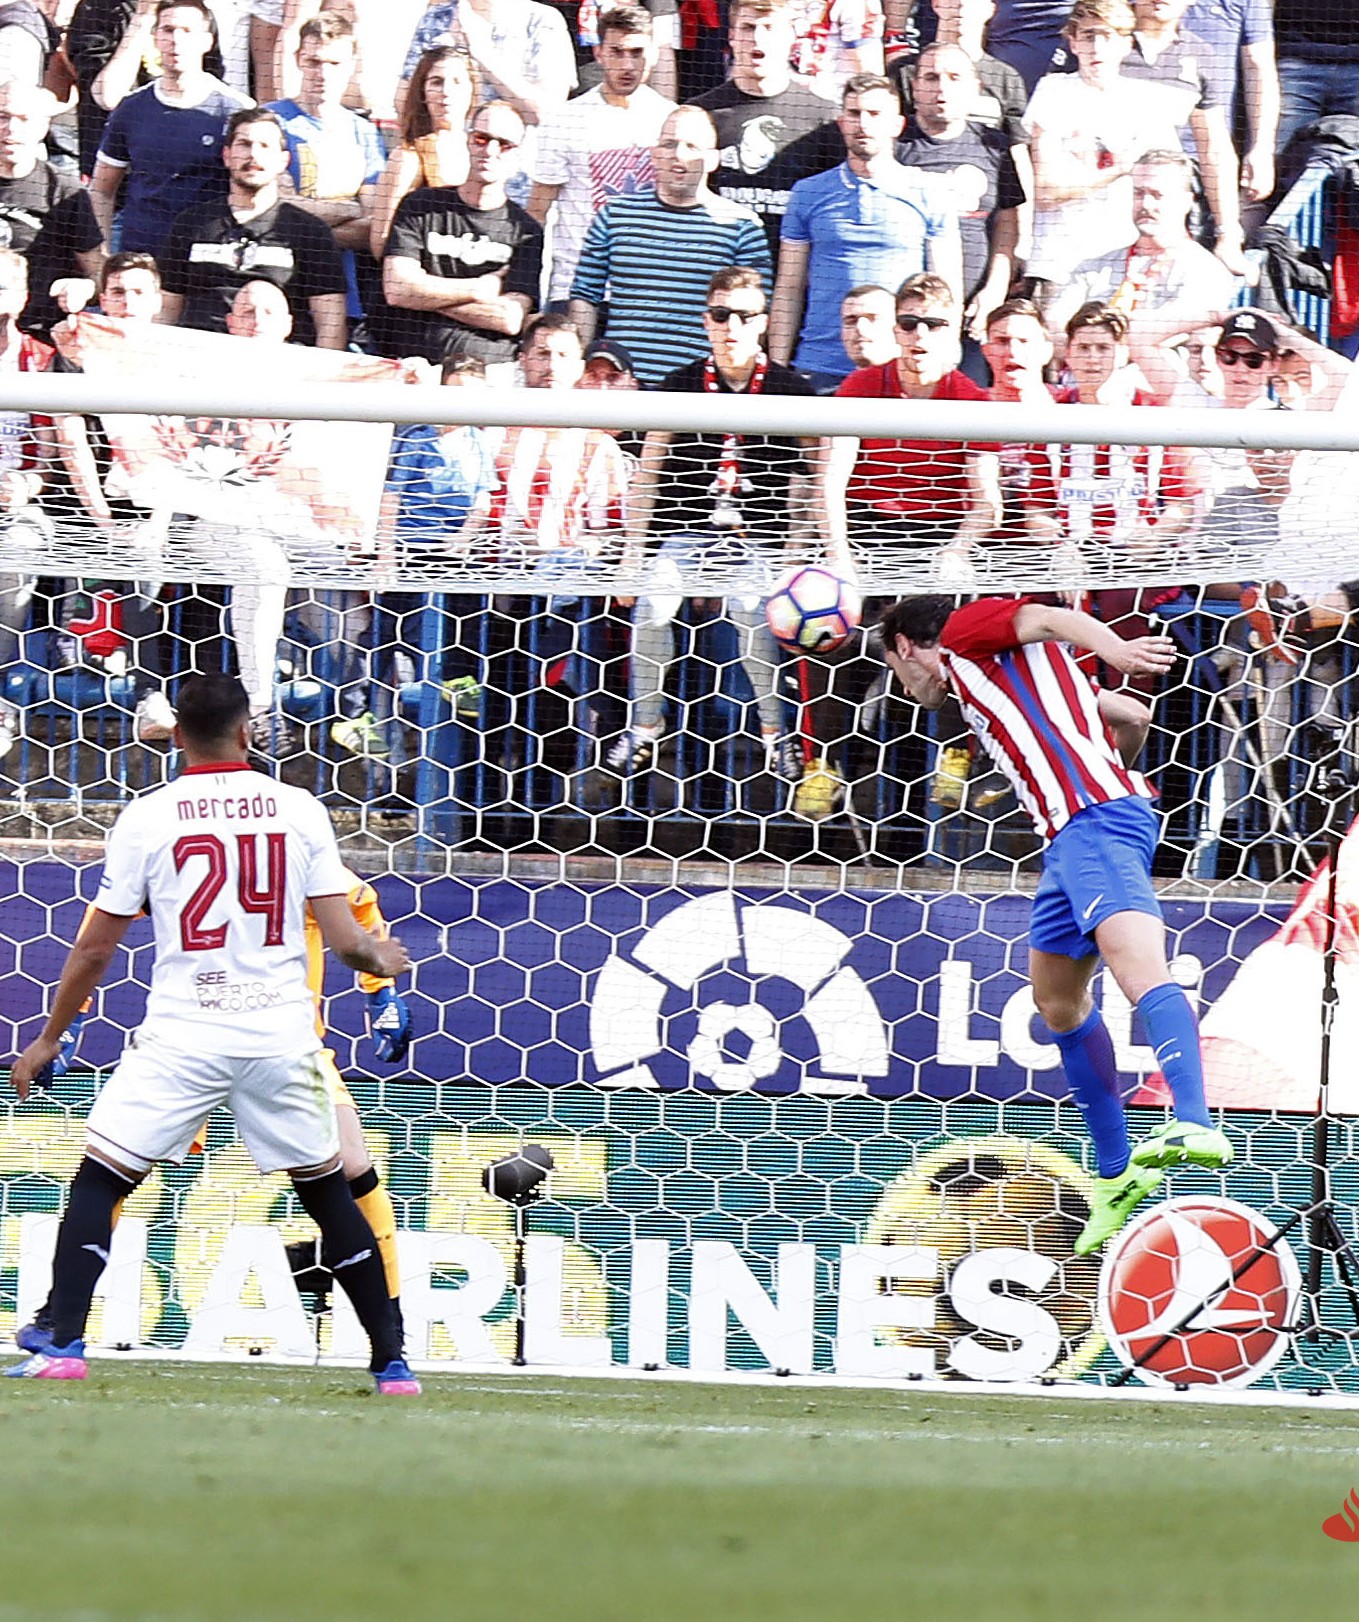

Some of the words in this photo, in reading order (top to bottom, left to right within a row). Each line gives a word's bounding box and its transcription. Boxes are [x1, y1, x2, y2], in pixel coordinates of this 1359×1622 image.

[177, 793, 277, 821] mercado
[172, 833, 288, 951] 24
[196, 971, 227, 986] SEE
[197, 981, 266, 1000] PUERTO
